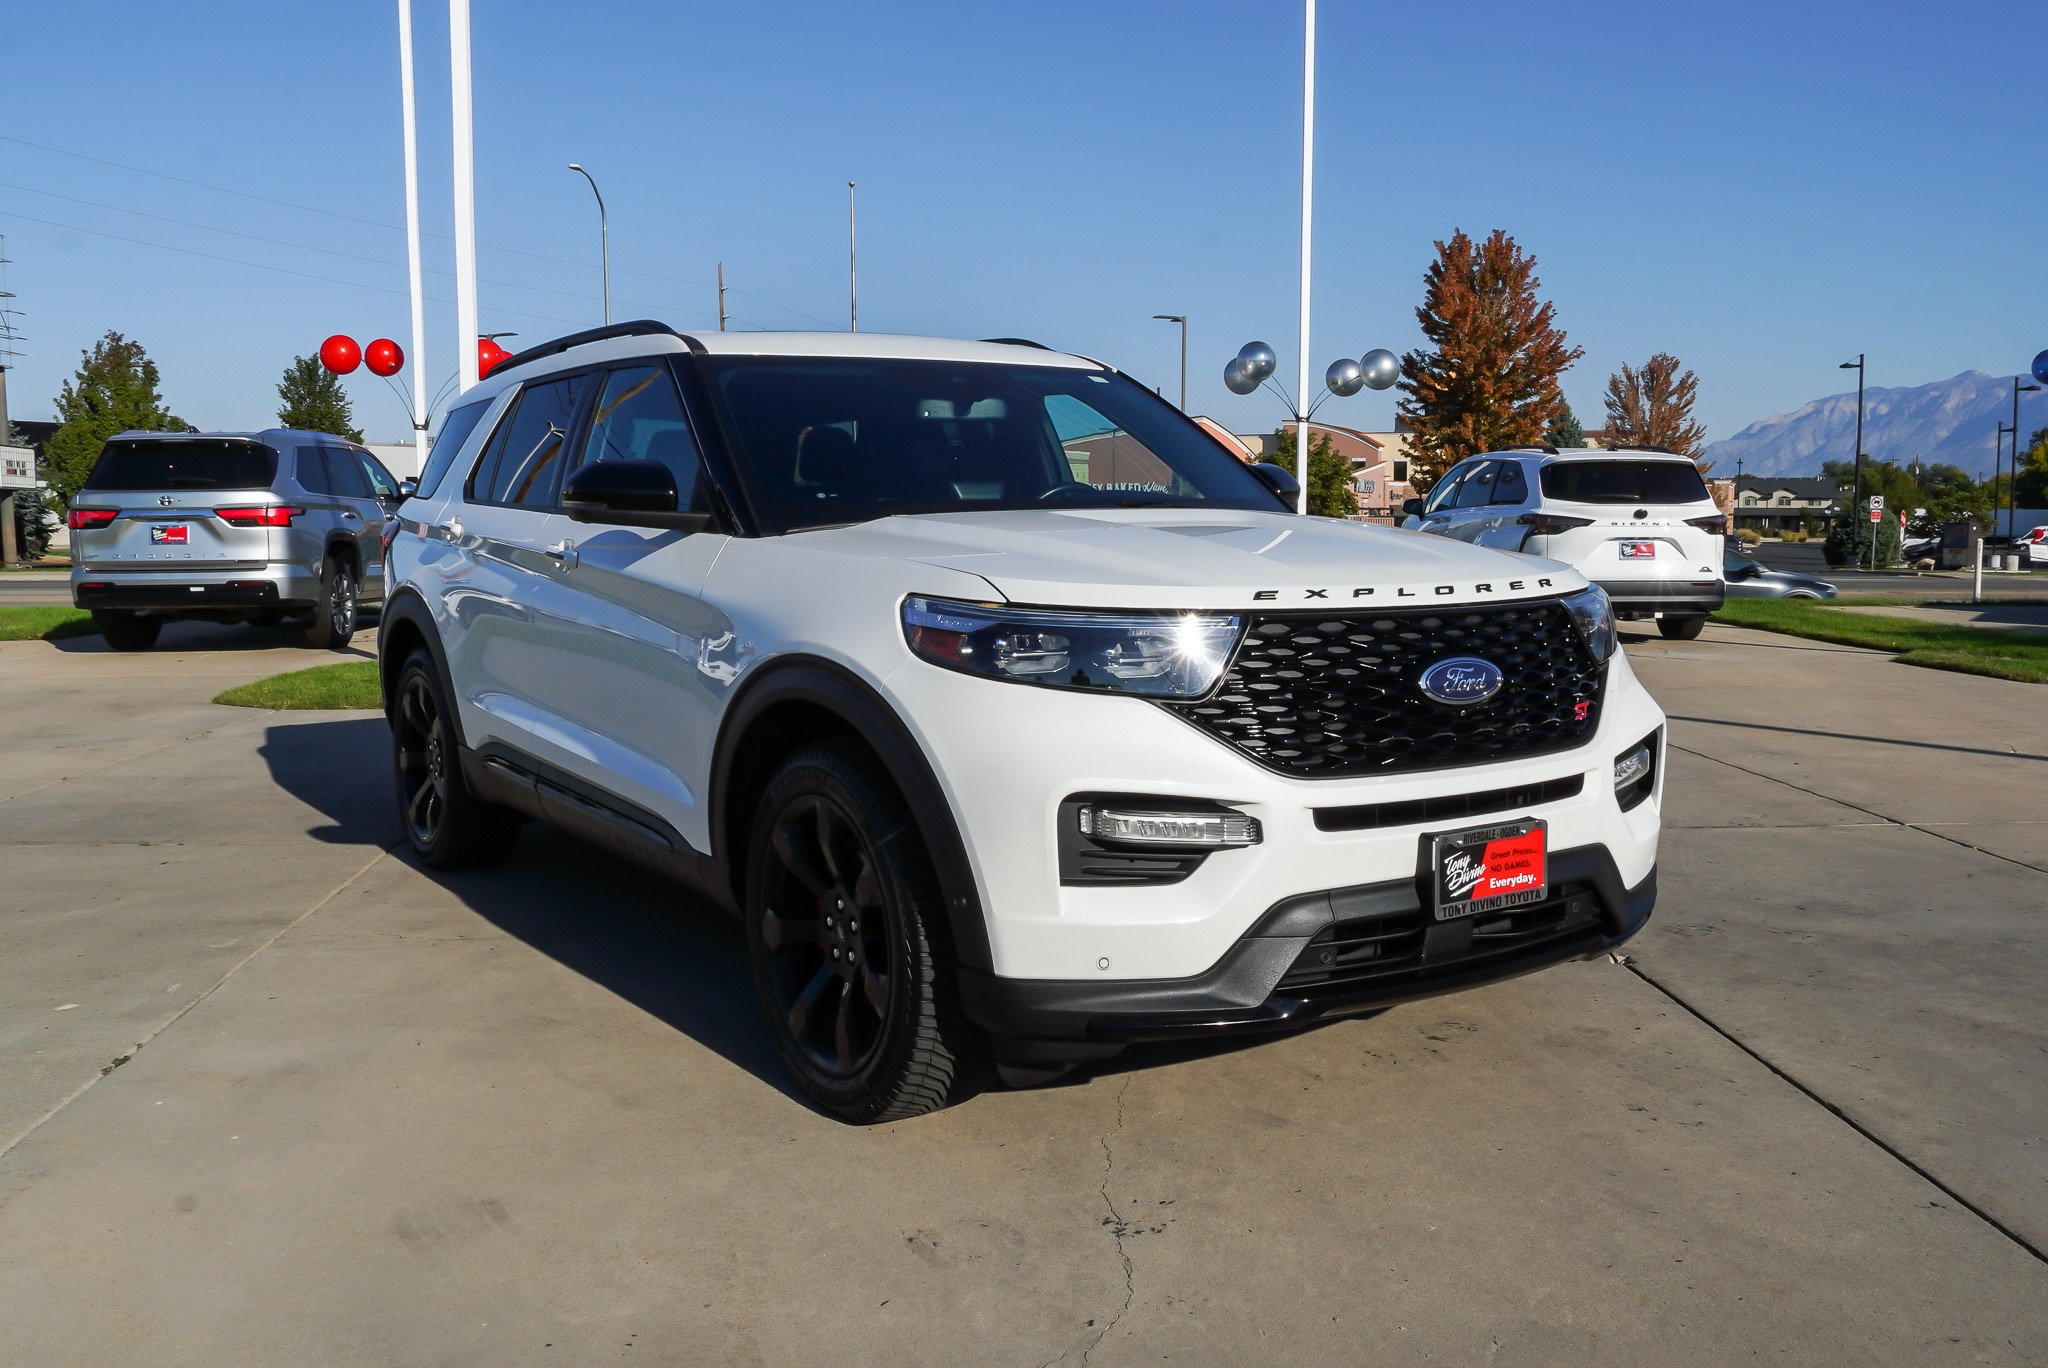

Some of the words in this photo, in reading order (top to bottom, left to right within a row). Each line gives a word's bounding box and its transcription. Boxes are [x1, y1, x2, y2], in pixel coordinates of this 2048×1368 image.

[1252, 578, 1553, 600] EXPLORER
[1444, 667, 1487, 693] Ford
[1575, 701, 1589, 720] ST
[1463, 829, 1496, 844] RIVERDALE
[1500, 826, 1520, 839] OGDEN
[1444, 851, 1471, 875] Tony
[1490, 851, 1511, 860] Great
[1445, 864, 1486, 890] Divino
[1490, 864, 1502, 872] NO
[1490, 872, 1536, 889] Everyday.
[1442, 904, 1467, 918] TONY
[1470, 896, 1501, 912] DIVINO
[1504, 889, 1541, 905] TOYOTA
